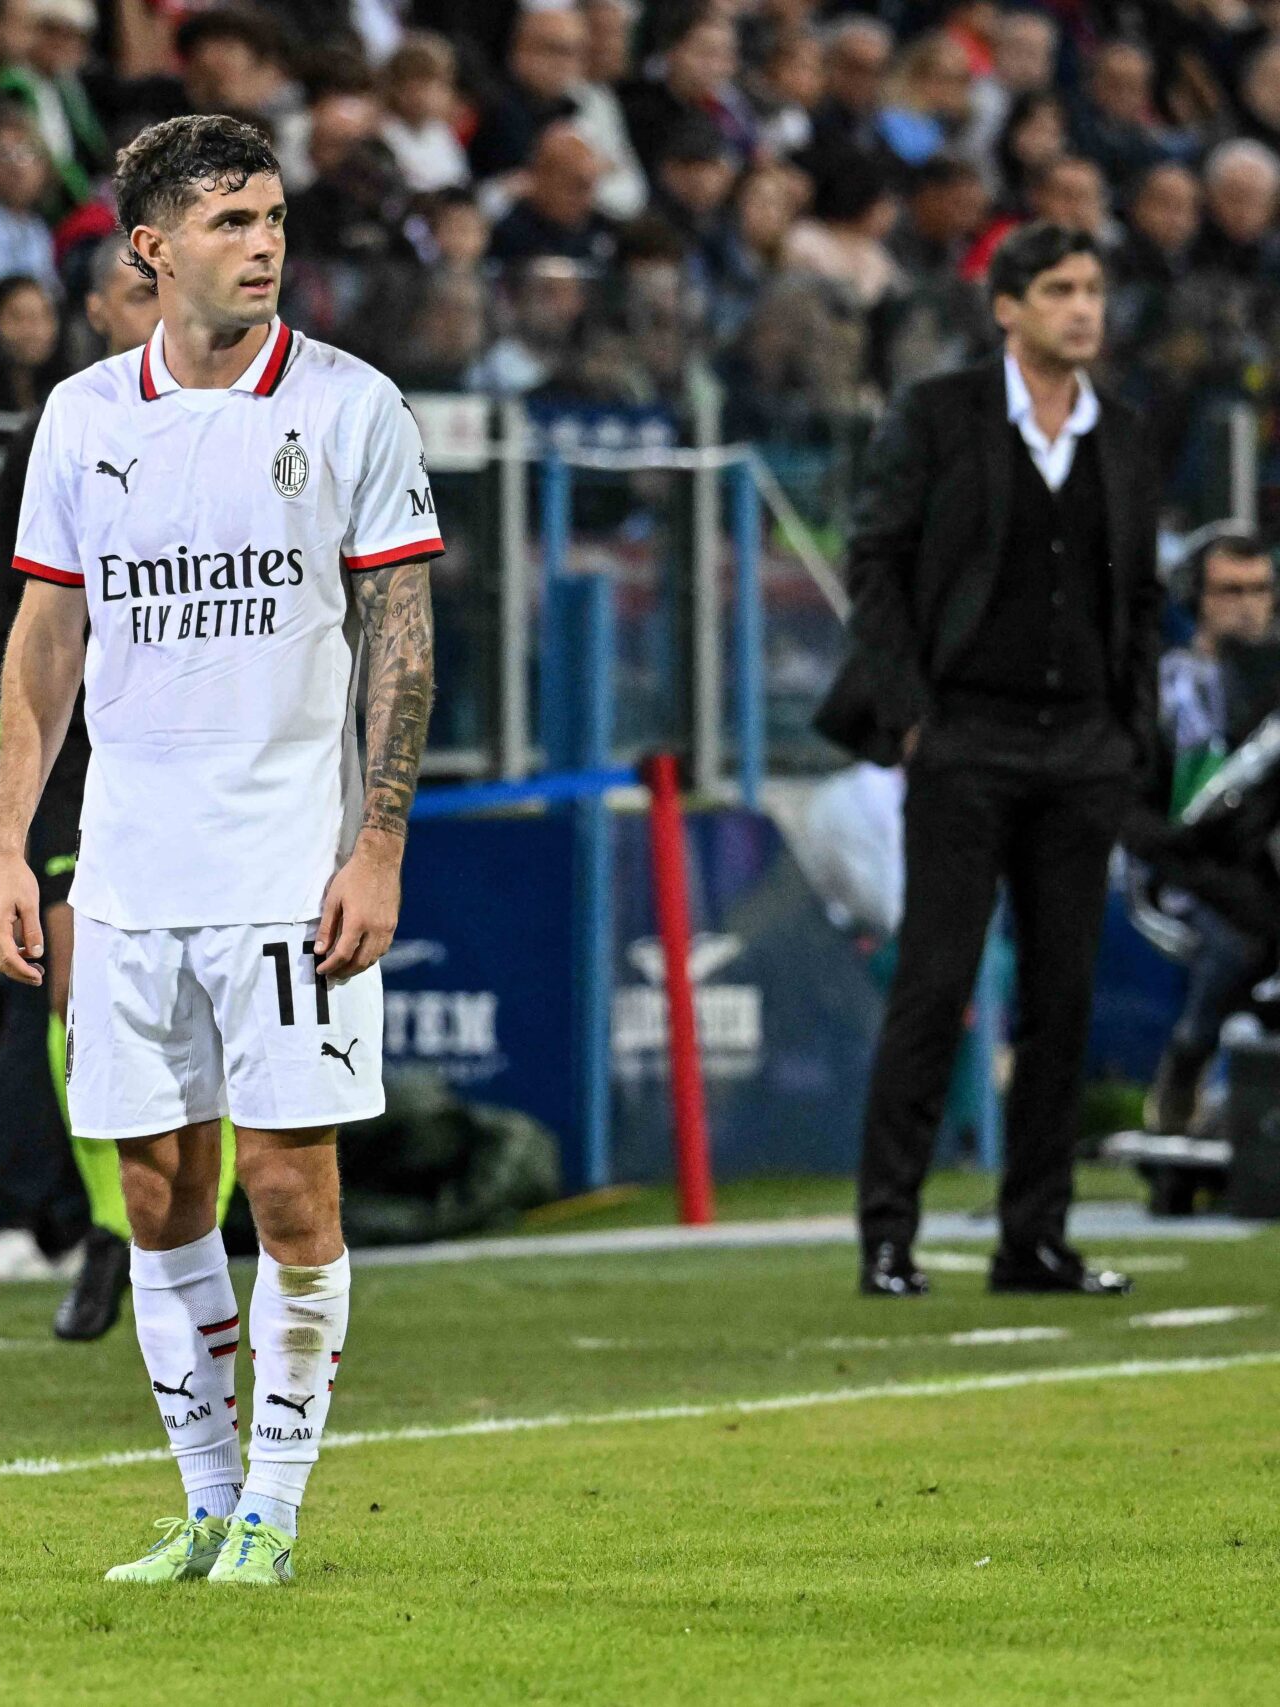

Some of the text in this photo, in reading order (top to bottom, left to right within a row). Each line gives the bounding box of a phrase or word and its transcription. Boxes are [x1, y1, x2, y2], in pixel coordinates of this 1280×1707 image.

[282, 448, 301, 458] ACM
[99, 544, 303, 602] Emirates
[132, 598, 276, 643] FLY BETTER
[263, 941, 330, 1026] 11
[256, 1424, 313, 1441] MILAN
